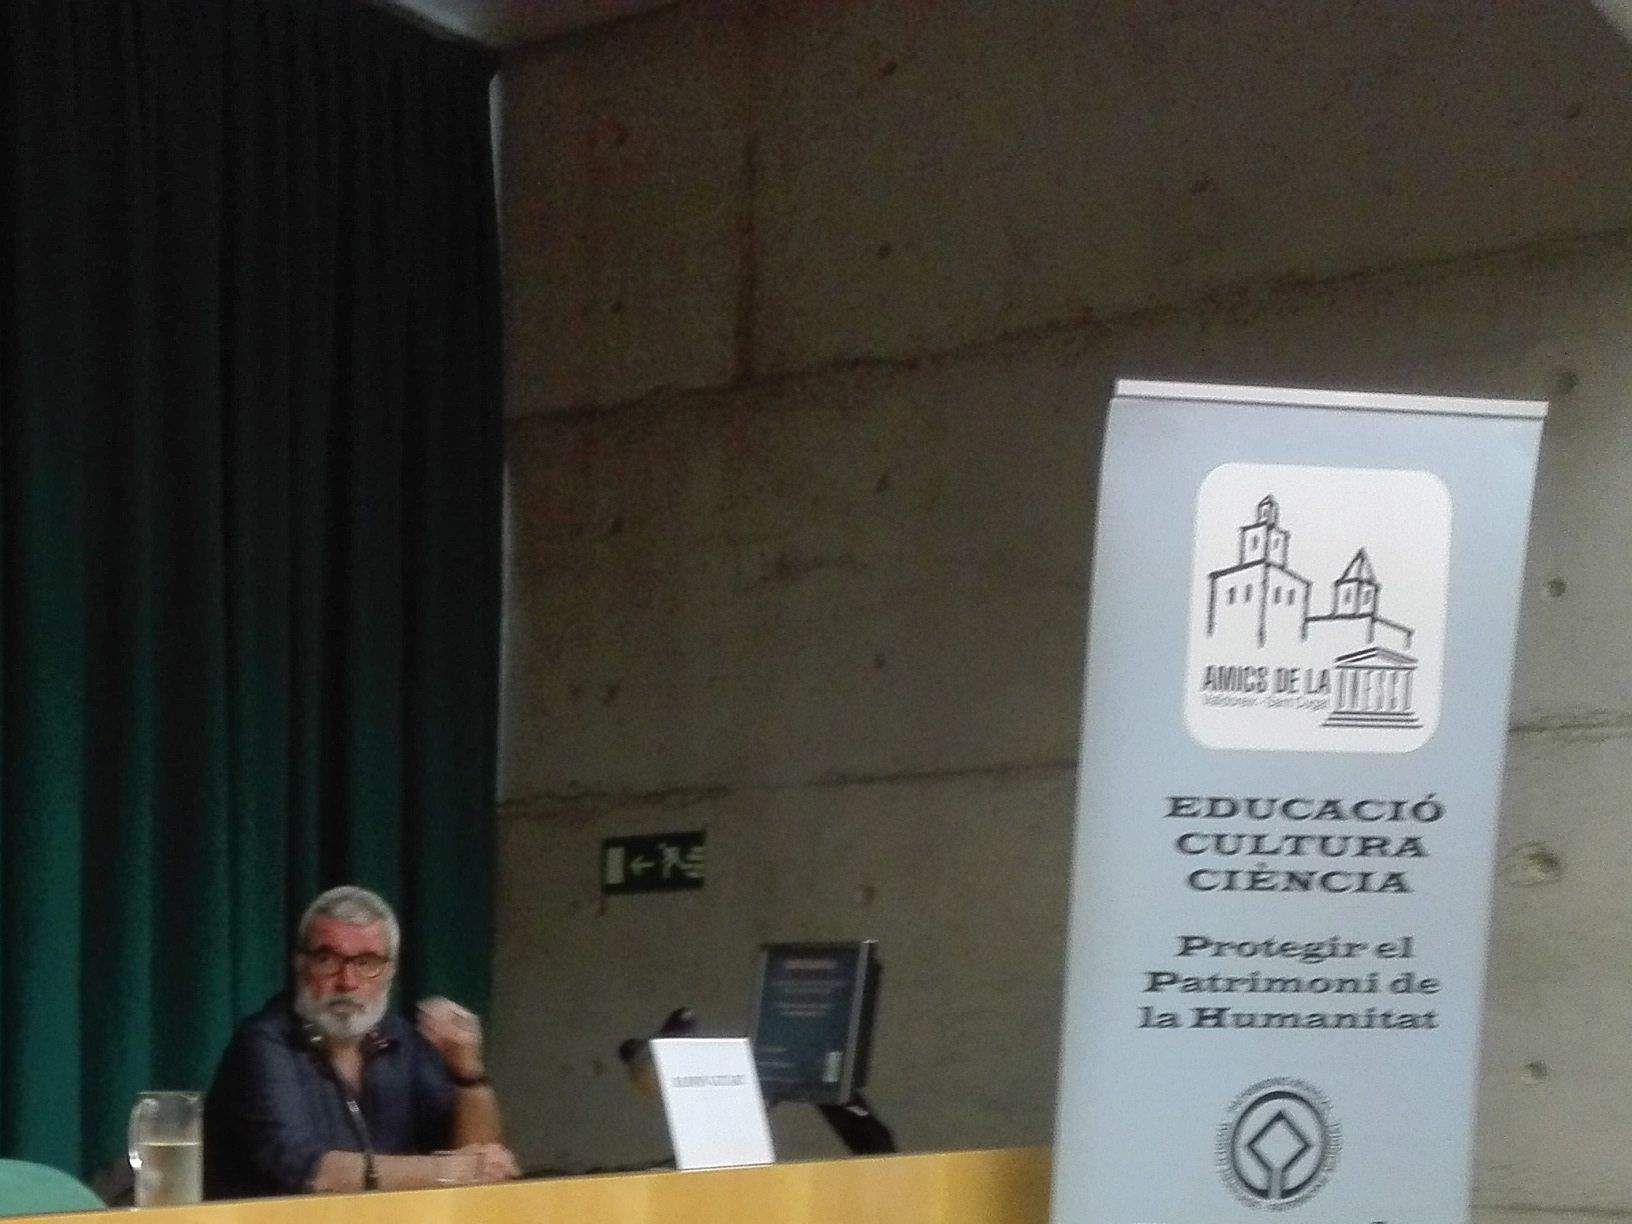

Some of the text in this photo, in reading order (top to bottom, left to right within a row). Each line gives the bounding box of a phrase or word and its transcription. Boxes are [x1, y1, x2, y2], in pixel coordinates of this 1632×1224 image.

[1200, 664, 1268, 692] AMICS
[1272, 666, 1301, 694] DE
[1302, 667, 1332, 695] LA
[1164, 793, 1447, 823] EDUCACIÓ
[1175, 832, 1430, 858] CULTURA
[1175, 935, 1415, 965] Protegir el
[1141, 971, 1442, 995] Patrimoni de
[1136, 1005, 1441, 1030] la Humanitat
